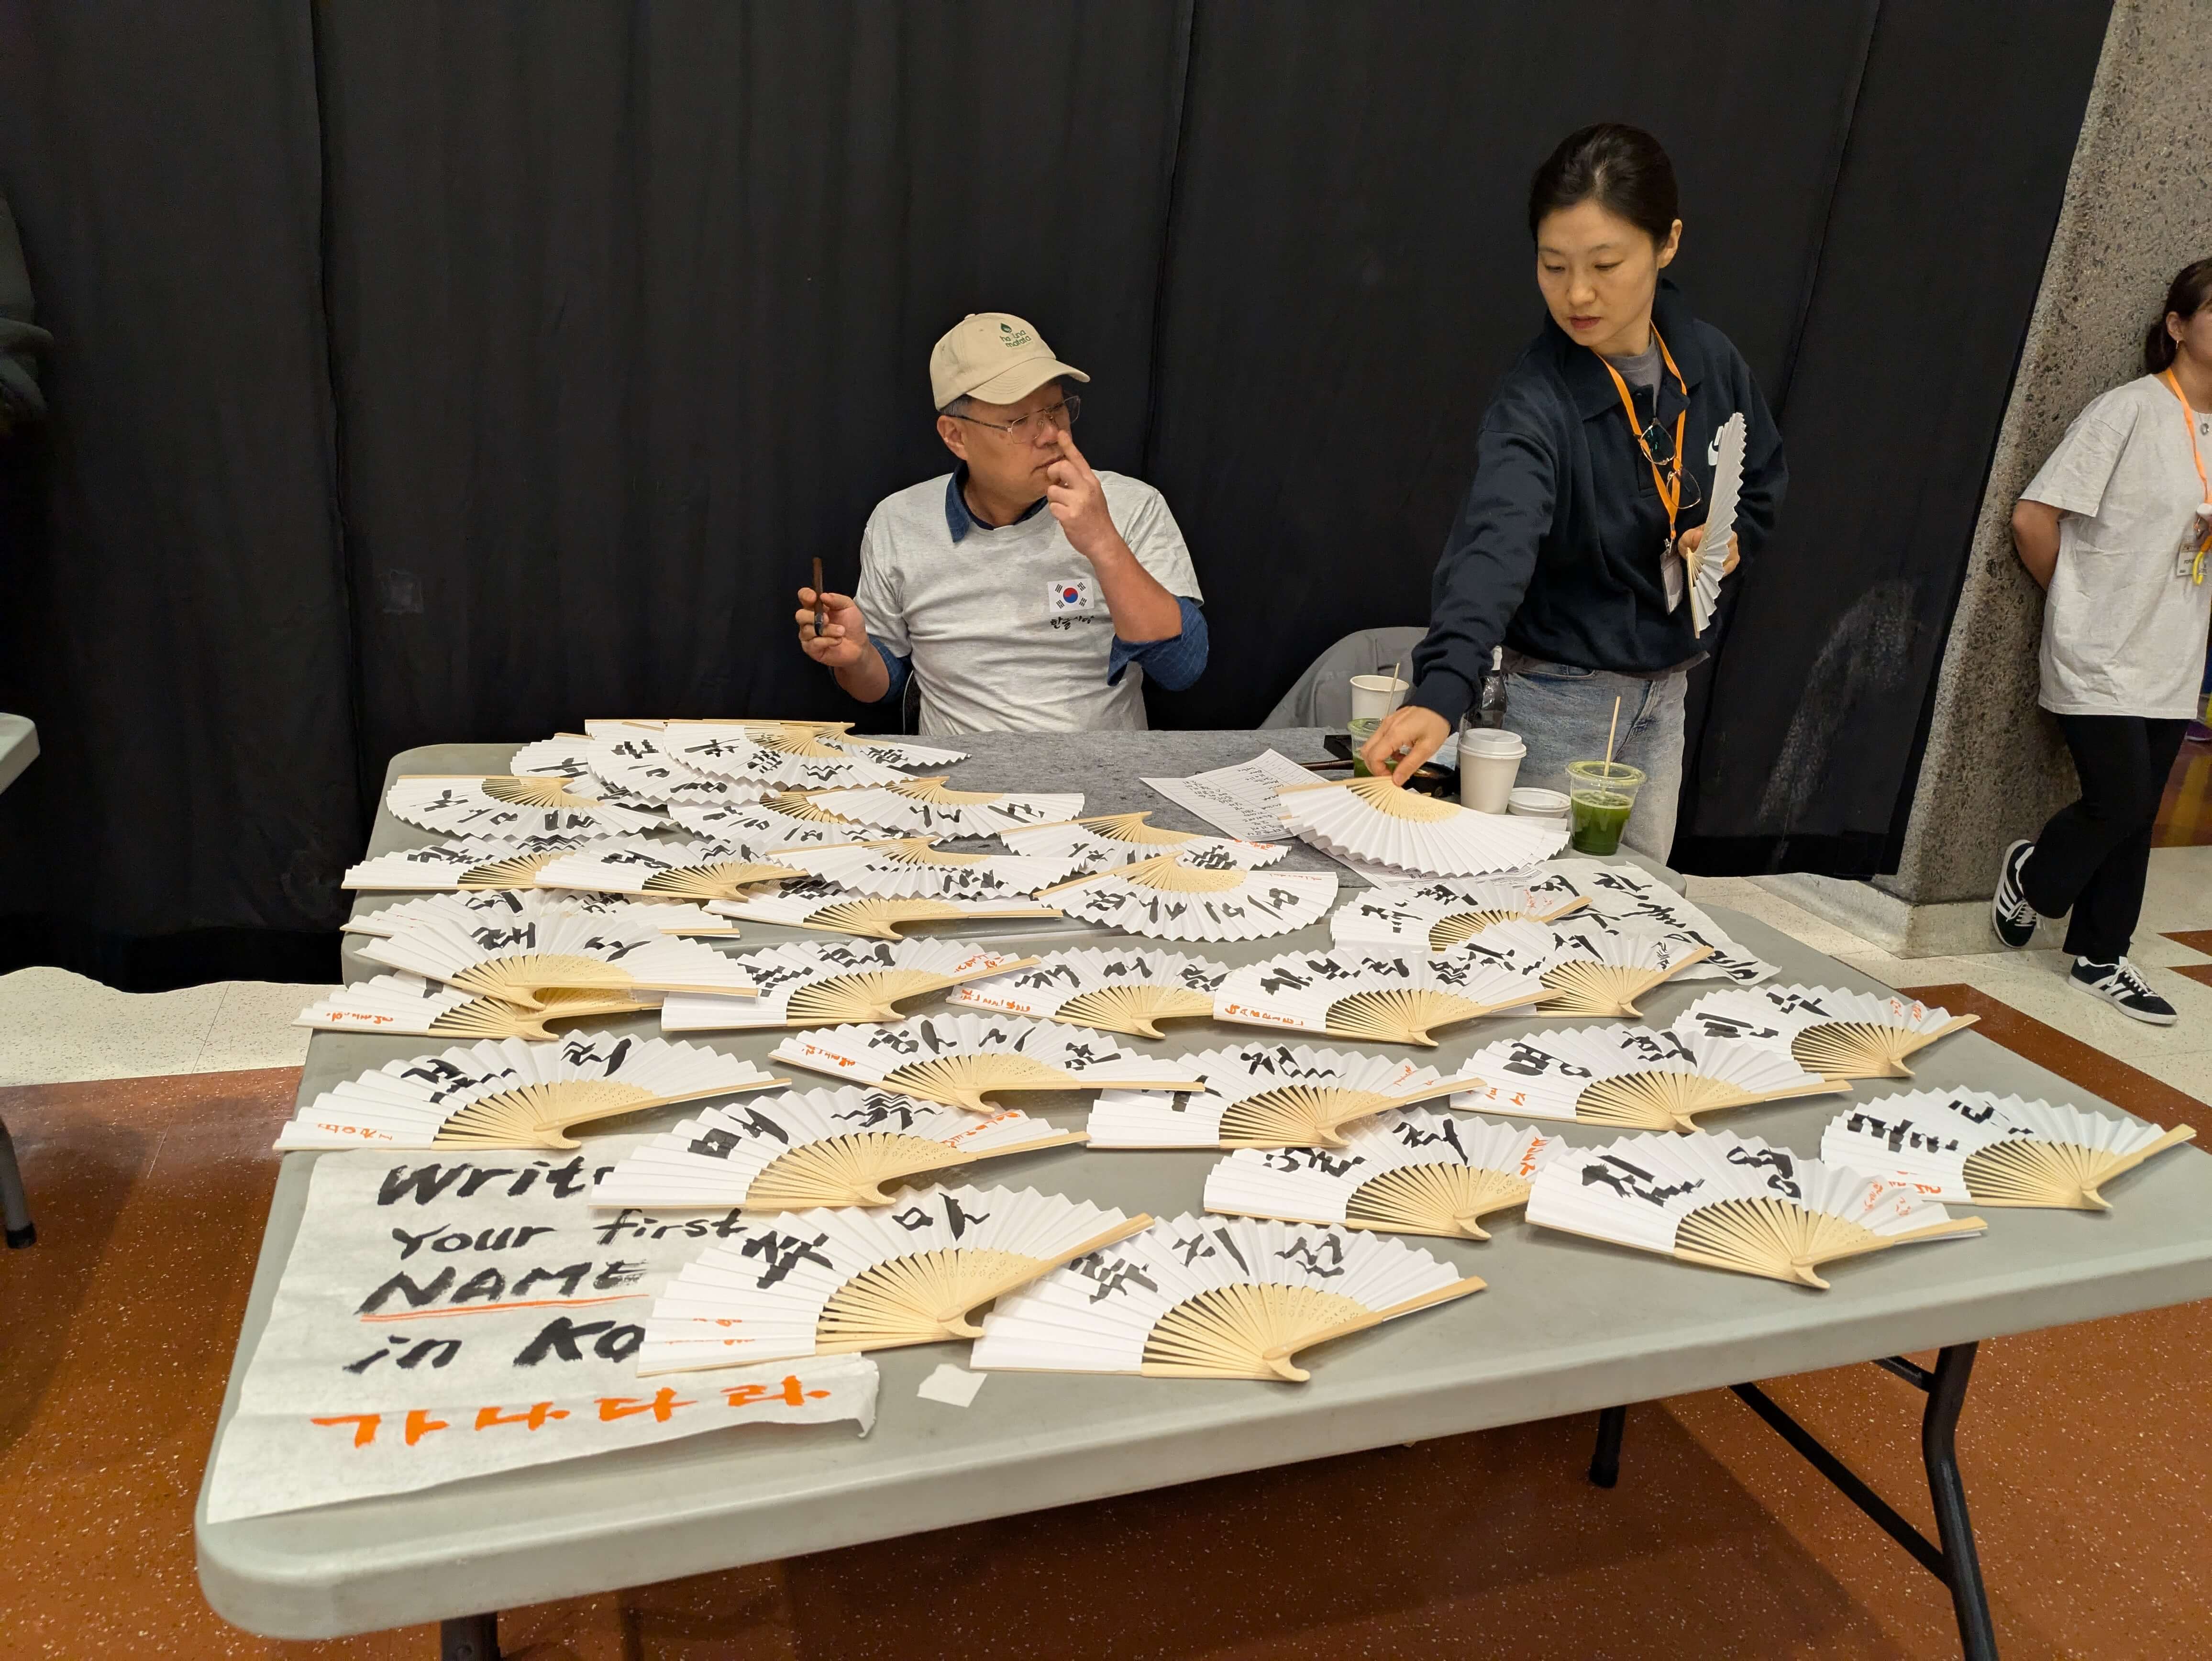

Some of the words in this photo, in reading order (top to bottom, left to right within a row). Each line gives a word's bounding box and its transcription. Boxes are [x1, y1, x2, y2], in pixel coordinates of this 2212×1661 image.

[593, 1207, 754, 1246] first
[353, 1259, 649, 1316] NAME
[342, 1334, 463, 1374] in
